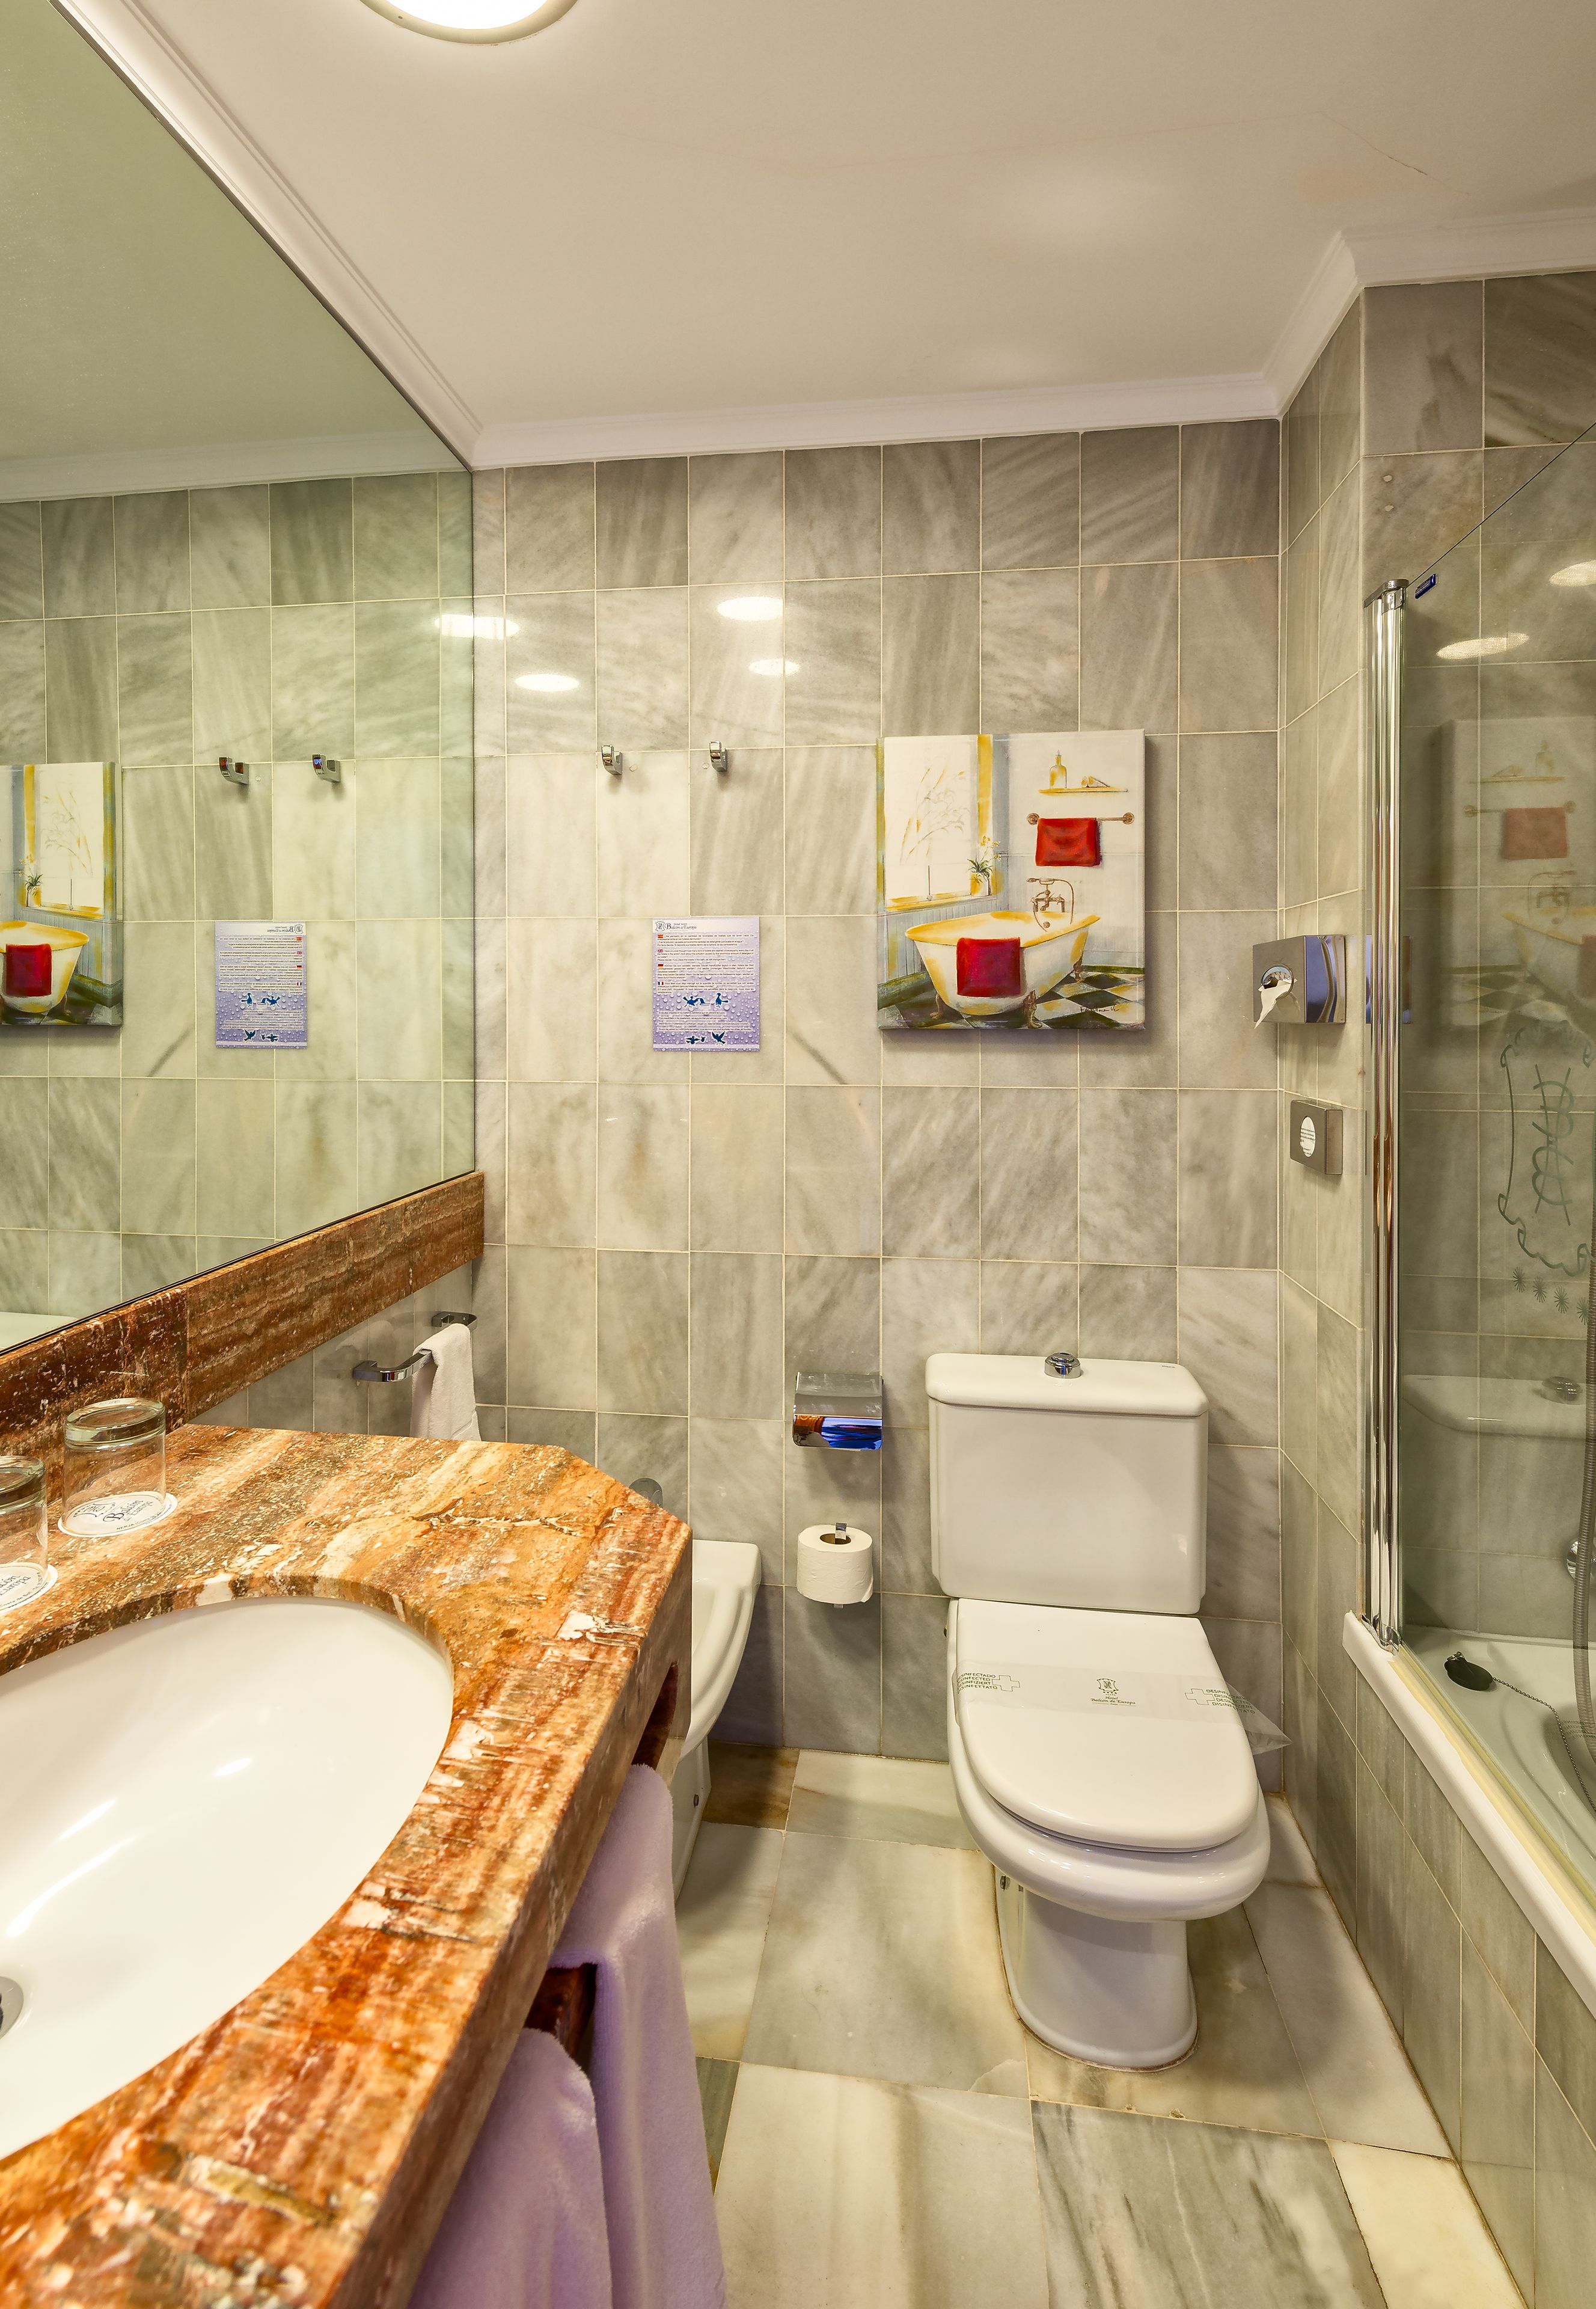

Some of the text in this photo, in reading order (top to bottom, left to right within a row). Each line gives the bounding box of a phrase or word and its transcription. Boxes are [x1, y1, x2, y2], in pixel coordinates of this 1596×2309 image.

[957, 1672, 996, 1682] SINFECTADO
[957, 1676, 991, 1685] SINFECTED
[957, 1681, 991, 1689] SINFIZIERT
